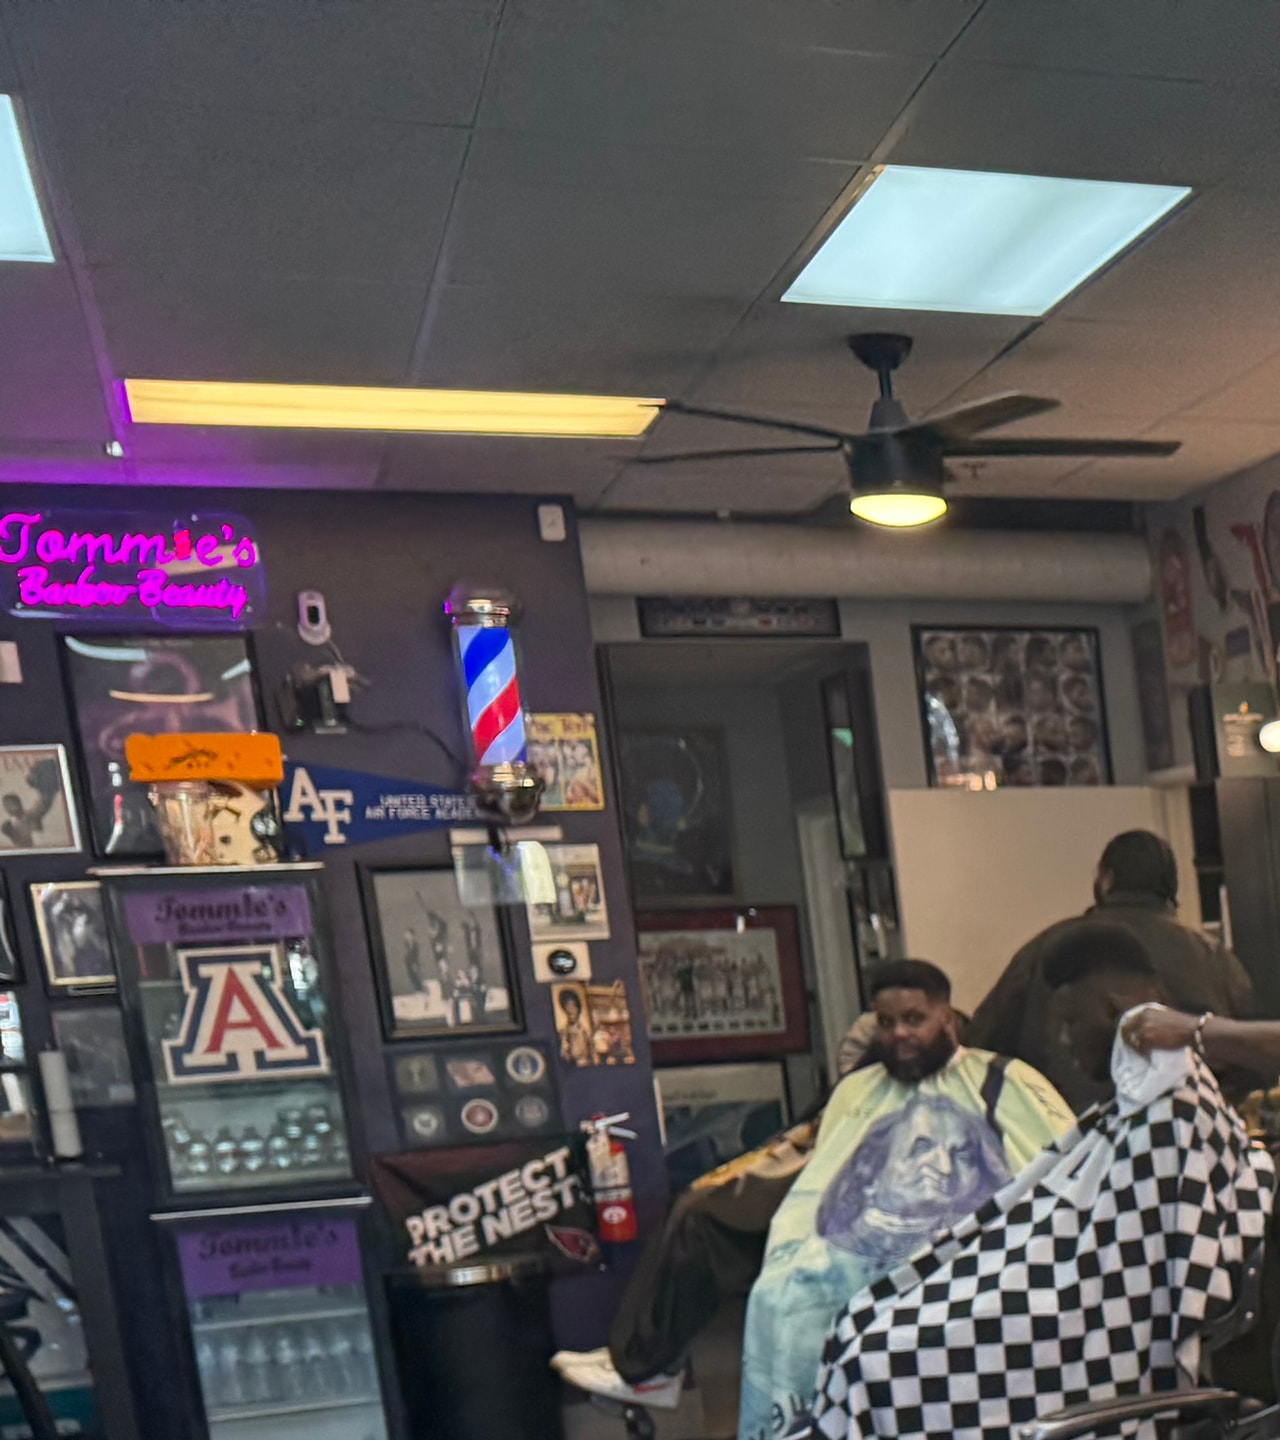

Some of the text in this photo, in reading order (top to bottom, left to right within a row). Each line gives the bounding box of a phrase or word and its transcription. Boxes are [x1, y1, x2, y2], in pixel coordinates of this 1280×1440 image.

[284, 767, 353, 844] AF
[364, 806, 387, 820] AIR
[389, 806, 430, 821] FORCE
[161, 945, 331, 1085] A
[405, 1146, 570, 1246] PROTECT
[408, 1174, 581, 1267] THE NEST
